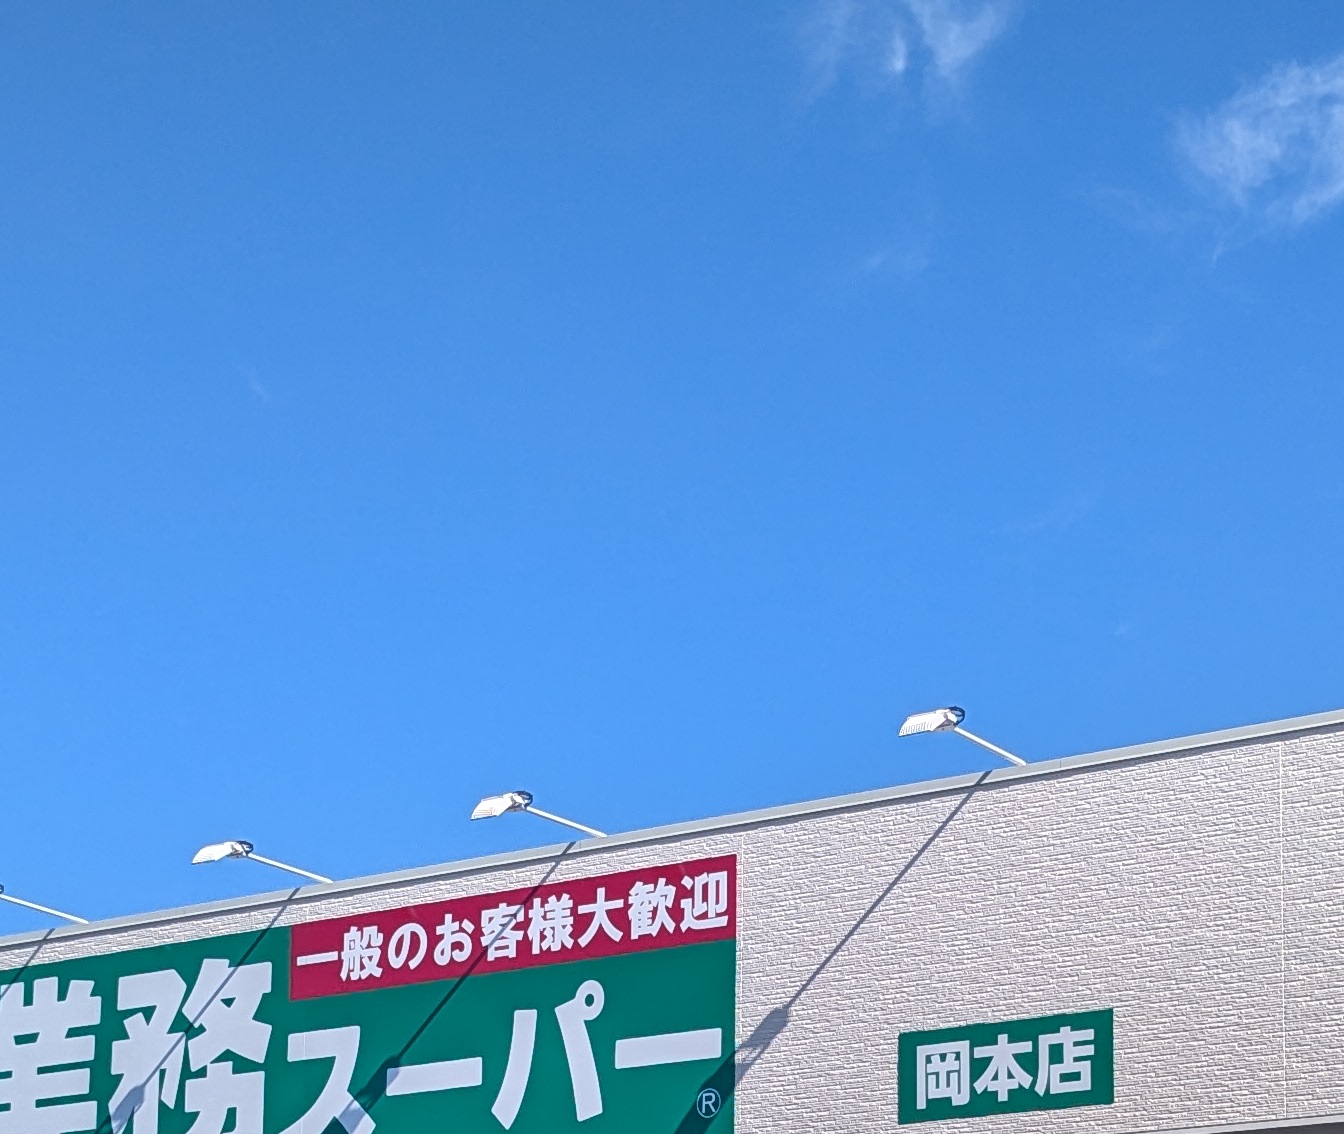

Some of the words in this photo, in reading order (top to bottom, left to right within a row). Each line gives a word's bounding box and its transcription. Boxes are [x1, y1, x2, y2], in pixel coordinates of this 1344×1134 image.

[296, 870, 729, 983] 一般のお客様大歓迎
[916, 1026, 1094, 1110] 岡本店
